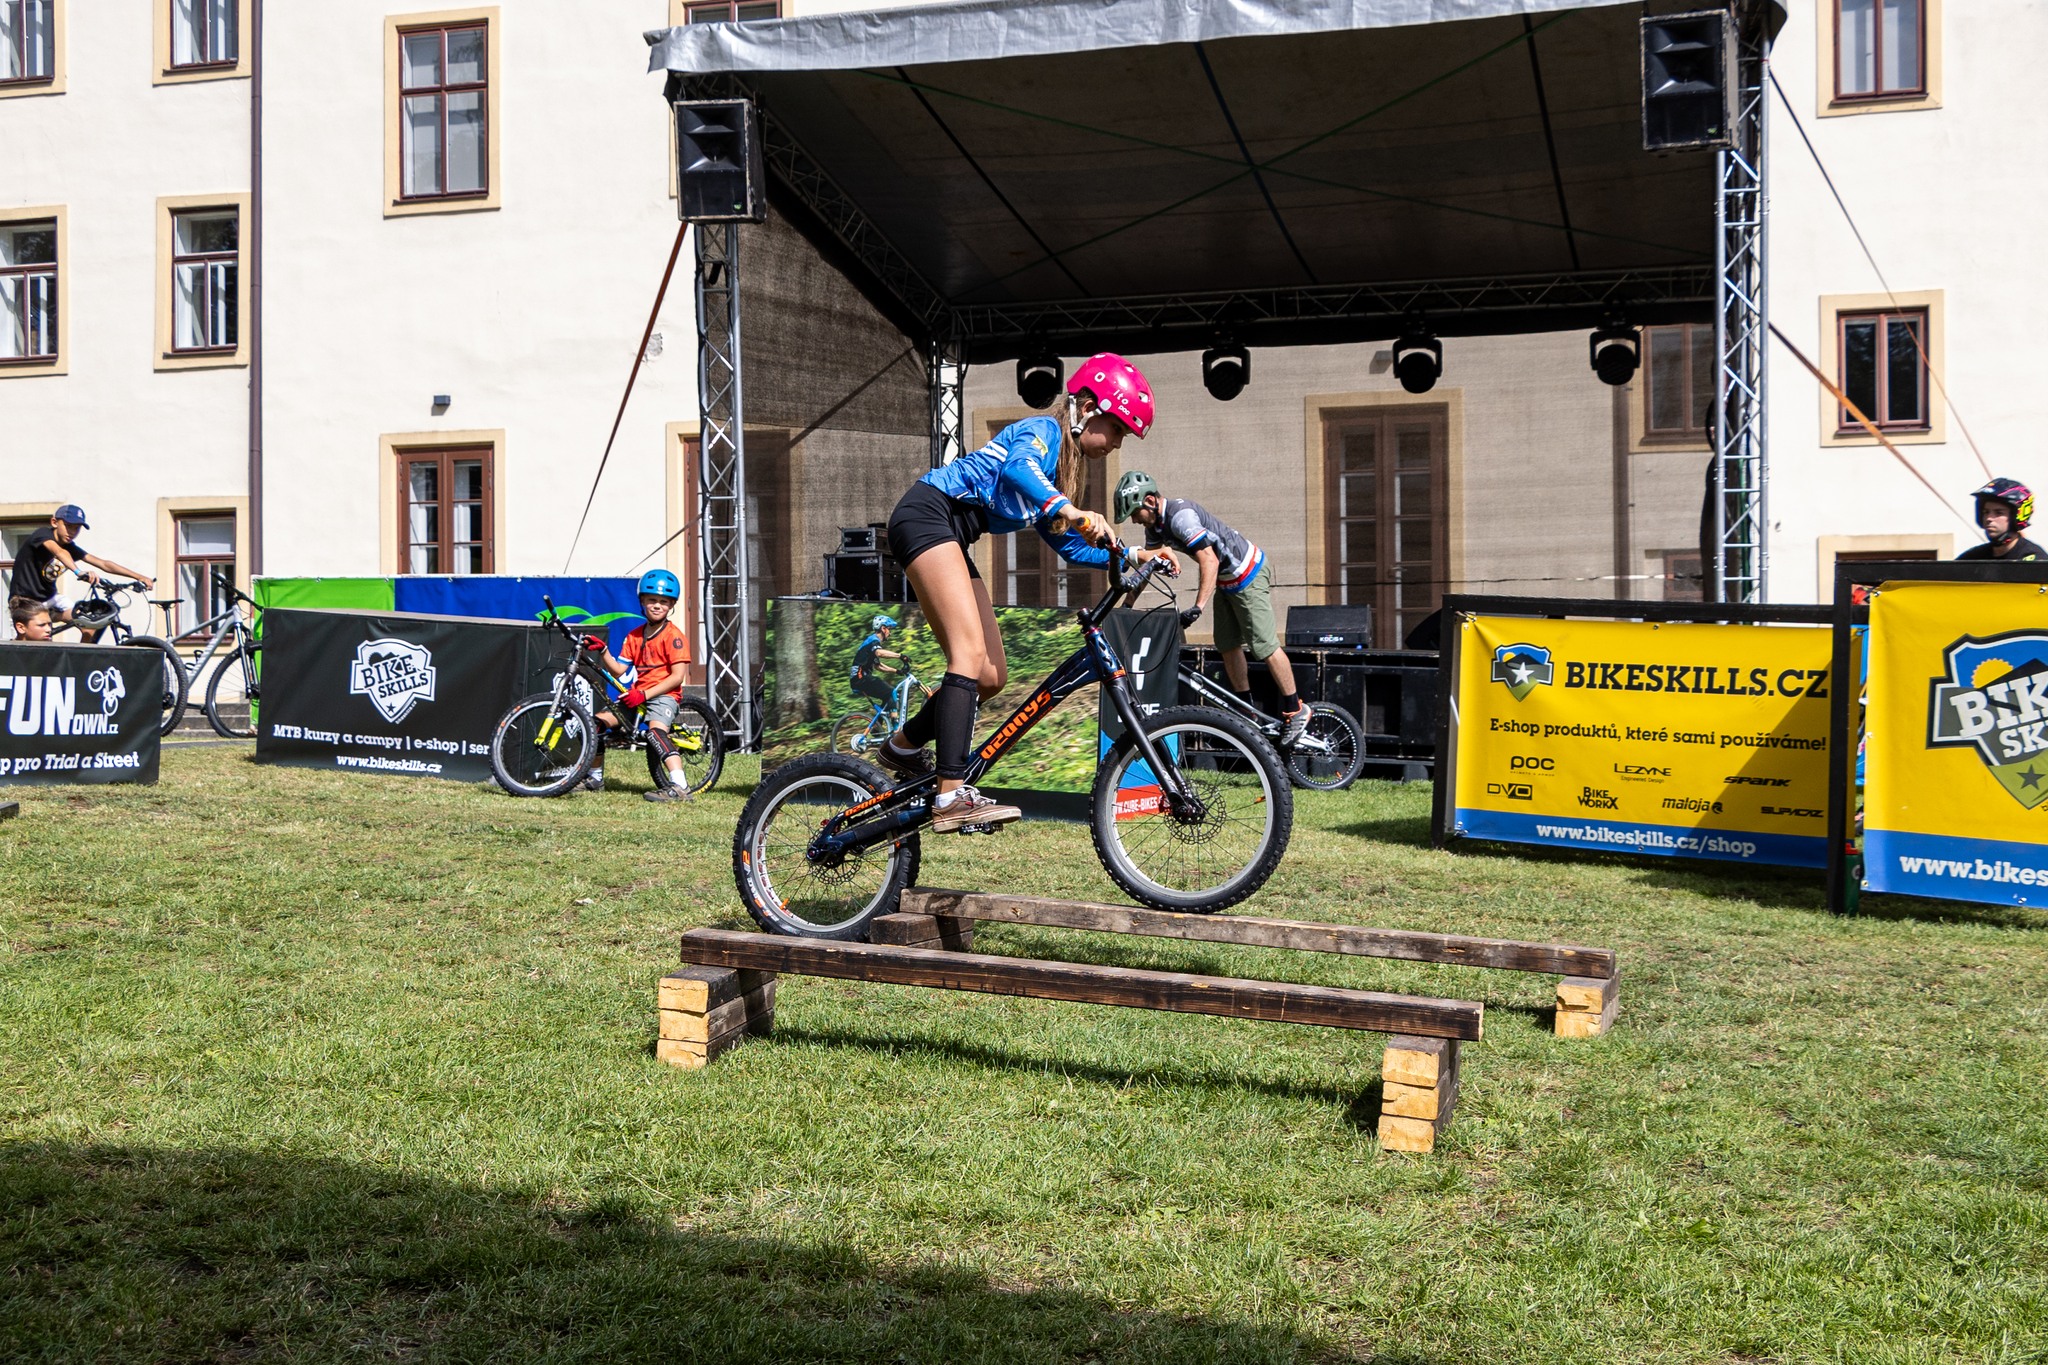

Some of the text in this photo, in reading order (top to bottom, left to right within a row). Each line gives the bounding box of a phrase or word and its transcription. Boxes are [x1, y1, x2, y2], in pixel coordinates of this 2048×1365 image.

[361, 654, 417, 689] BIKE
[1565, 661, 1829, 699] BIKESKILLS.CZ
[378, 672, 429, 698] SKILLS
[273, 724, 302, 739] MTB
[303, 727, 340, 745] kurzy
[342, 734, 353, 743] a
[355, 735, 402, 750] campy
[414, 740, 459, 754] e-shop
[1490, 718, 1827, 751] E-shop produktů, které sami používáme!
[13, 756, 41, 774] pro
[45, 753, 80, 770] Trial
[81, 756, 93, 768] a
[94, 751, 140, 768] Street
[337, 755, 442, 774] www.bikeskills.cz
[1510, 755, 1555, 771] POC
[1614, 763, 1672, 777] LEZYNE
[1487, 783, 1533, 800] DVO
[1583, 786, 1610, 799] BIKE
[1662, 797, 1711, 812] maloja
[1536, 824, 1756, 856] www.bikeskills.cz/shop
[1900, 856, 2048, 887] www.bikes
